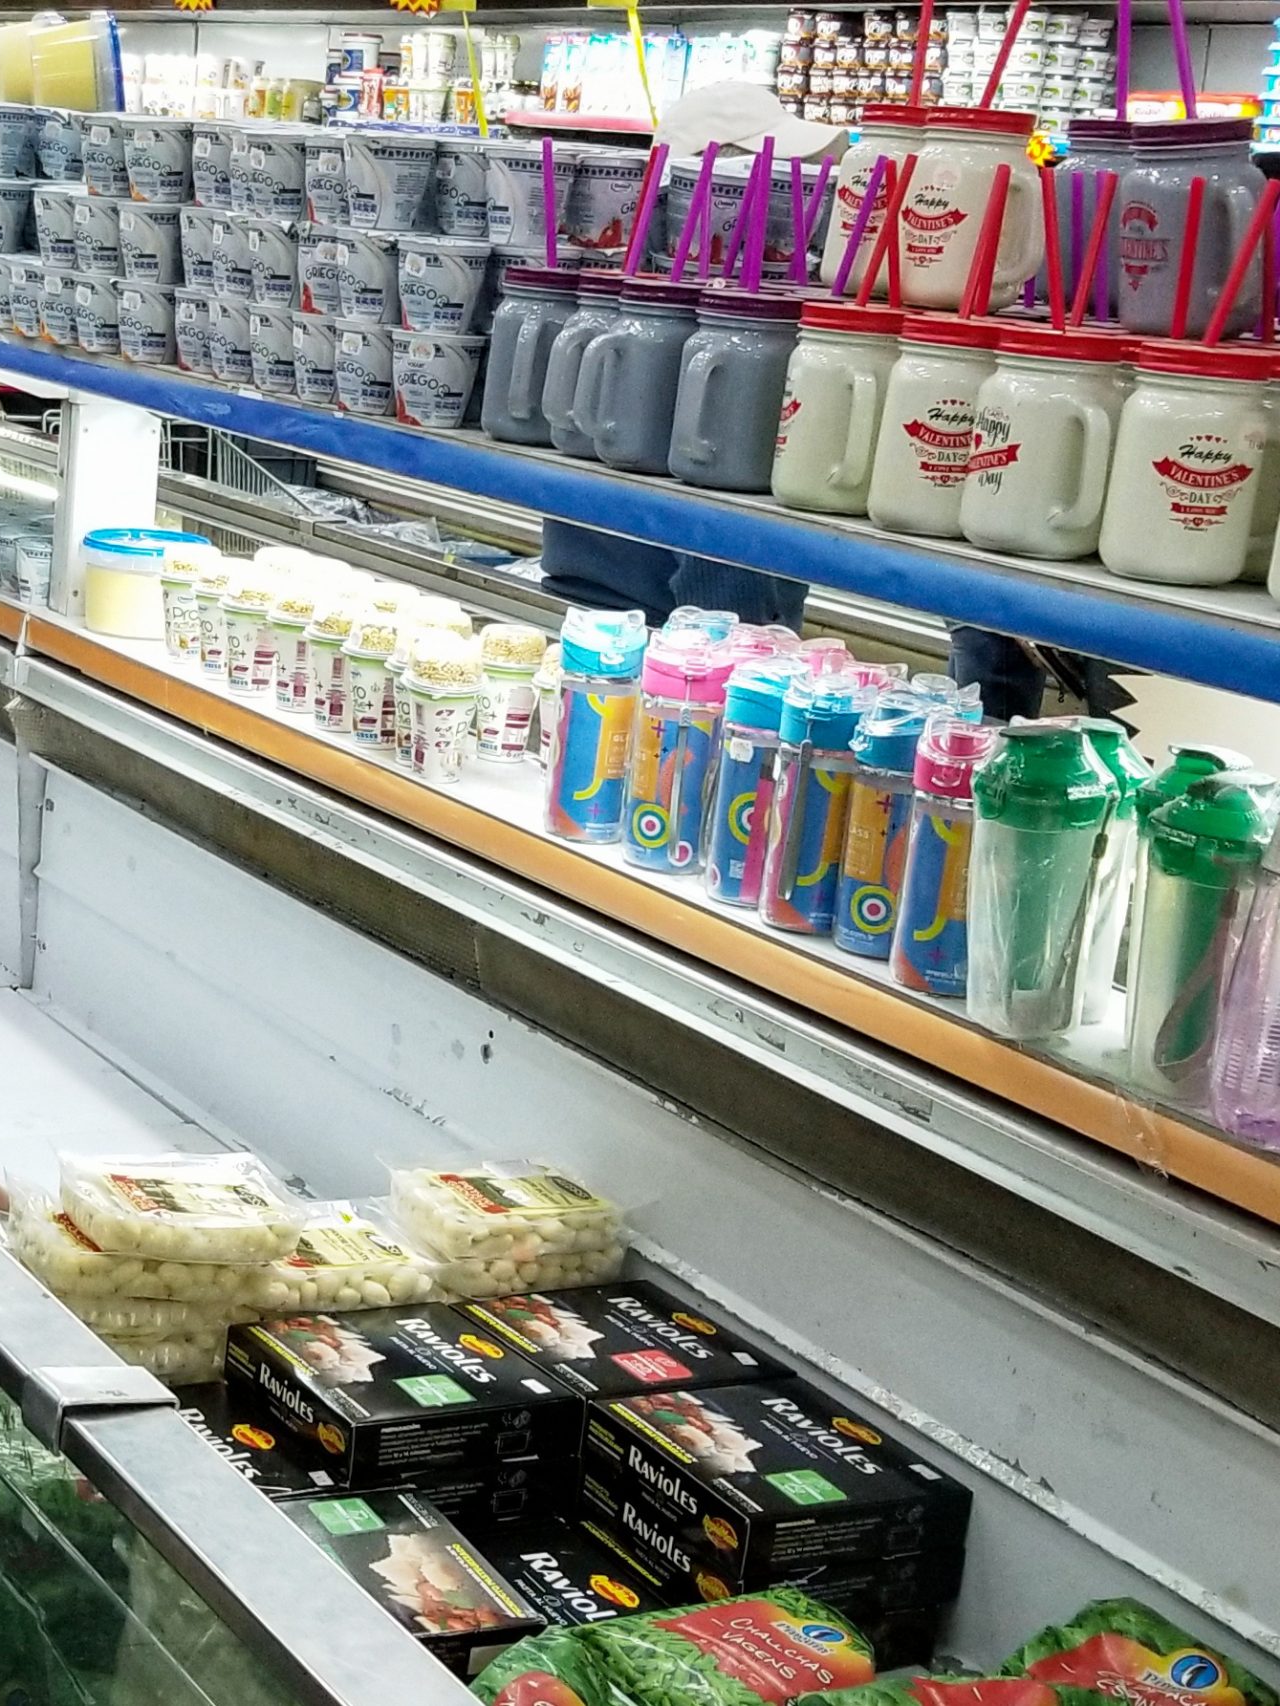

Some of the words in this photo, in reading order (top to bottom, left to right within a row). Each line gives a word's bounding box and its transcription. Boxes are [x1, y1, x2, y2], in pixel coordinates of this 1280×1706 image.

[927, 407, 975, 426] Happy
[976, 408, 1011, 447] Happy
[937, 451, 959, 462] DAY
[1178, 444, 1233, 464] Happy
[978, 471, 1003, 496] Day
[1189, 491, 1212, 504] DAY
[520, 1552, 618, 1622] RAVIOL
[722, 1631, 797, 1680] VAGENS
